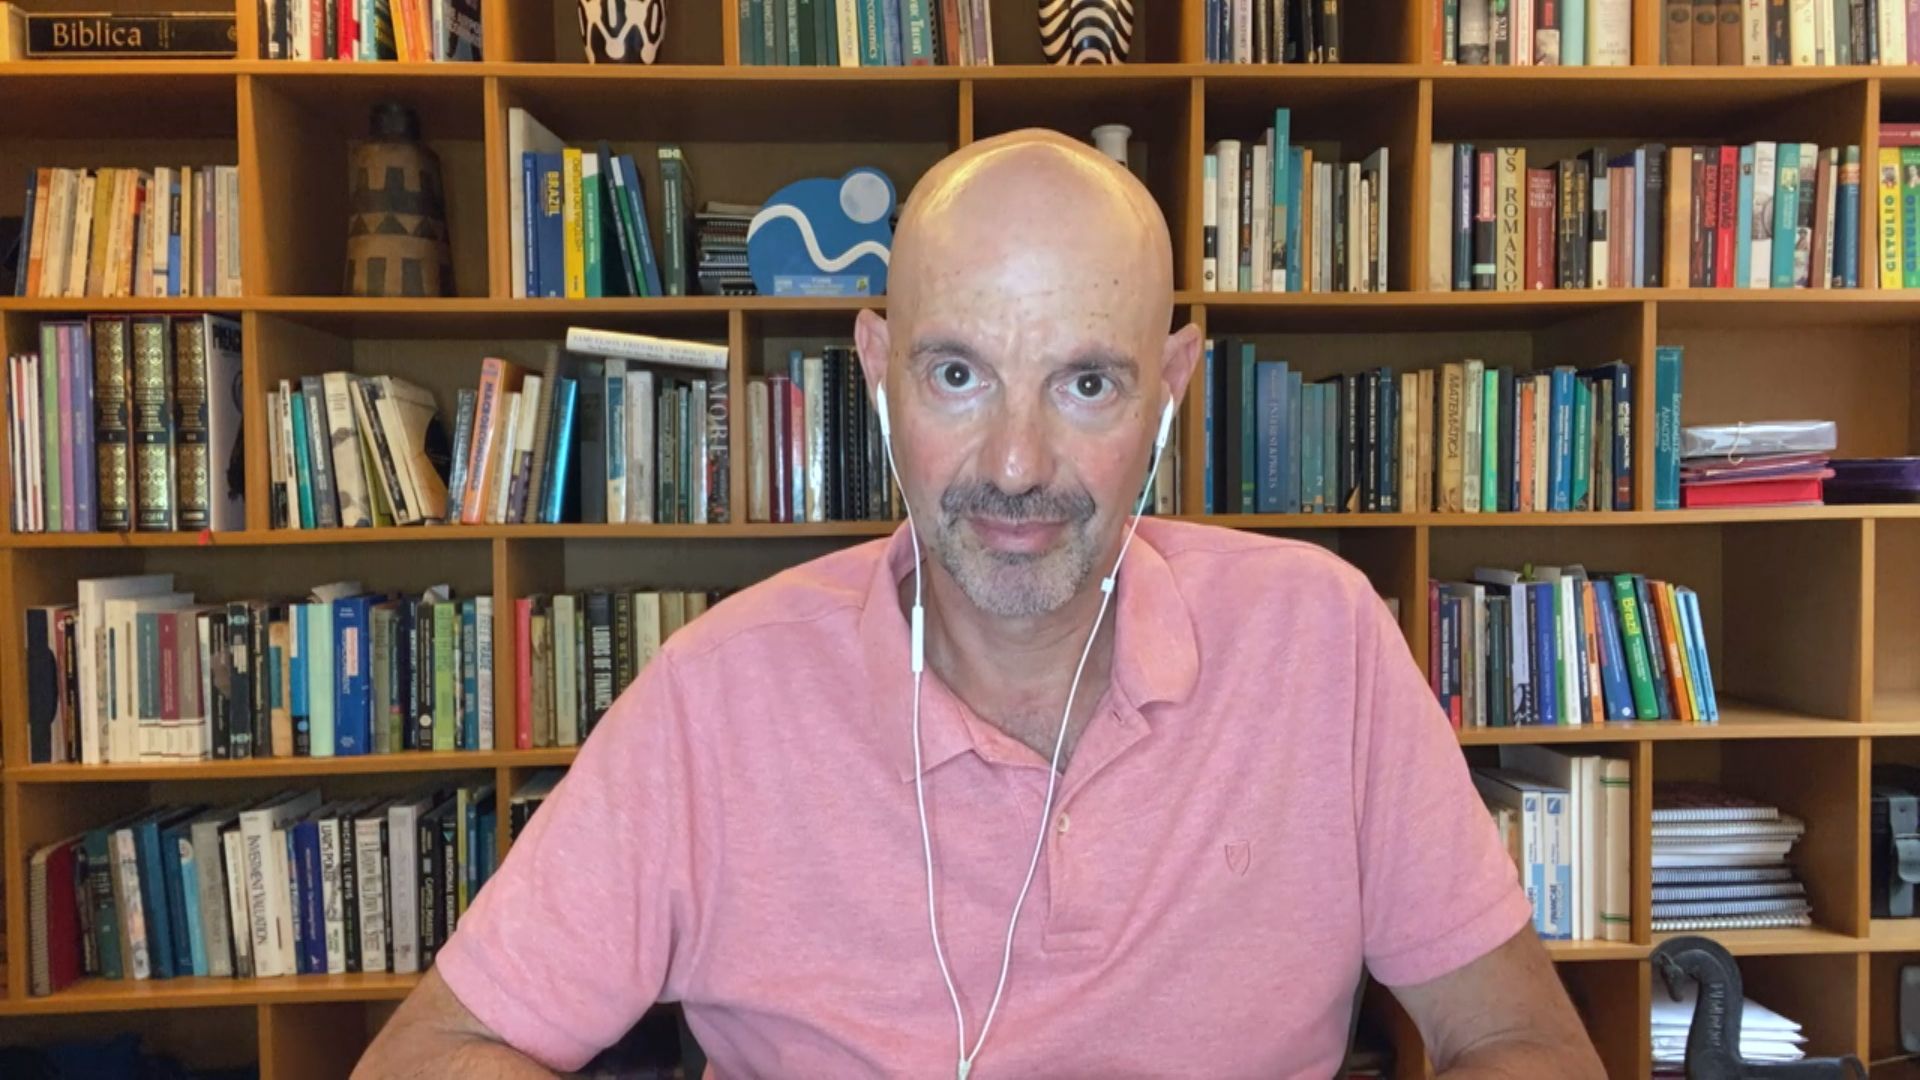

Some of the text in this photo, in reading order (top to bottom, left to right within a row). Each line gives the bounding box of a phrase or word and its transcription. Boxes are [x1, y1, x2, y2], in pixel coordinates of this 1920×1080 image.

[52, 20, 142, 48] Biblica
[547, 171, 561, 217] BRAZIL
[708, 381, 728, 457] MORE
[1621, 597, 1639, 636] Brazil
[480, 641, 492, 670] TRADE
[592, 625, 611, 656] LORDS
[593, 658, 611, 670] OF
[343, 820, 353, 900] MICHAEL LEWIS
[247, 834, 269, 946] INVESTMENT VALUATION
